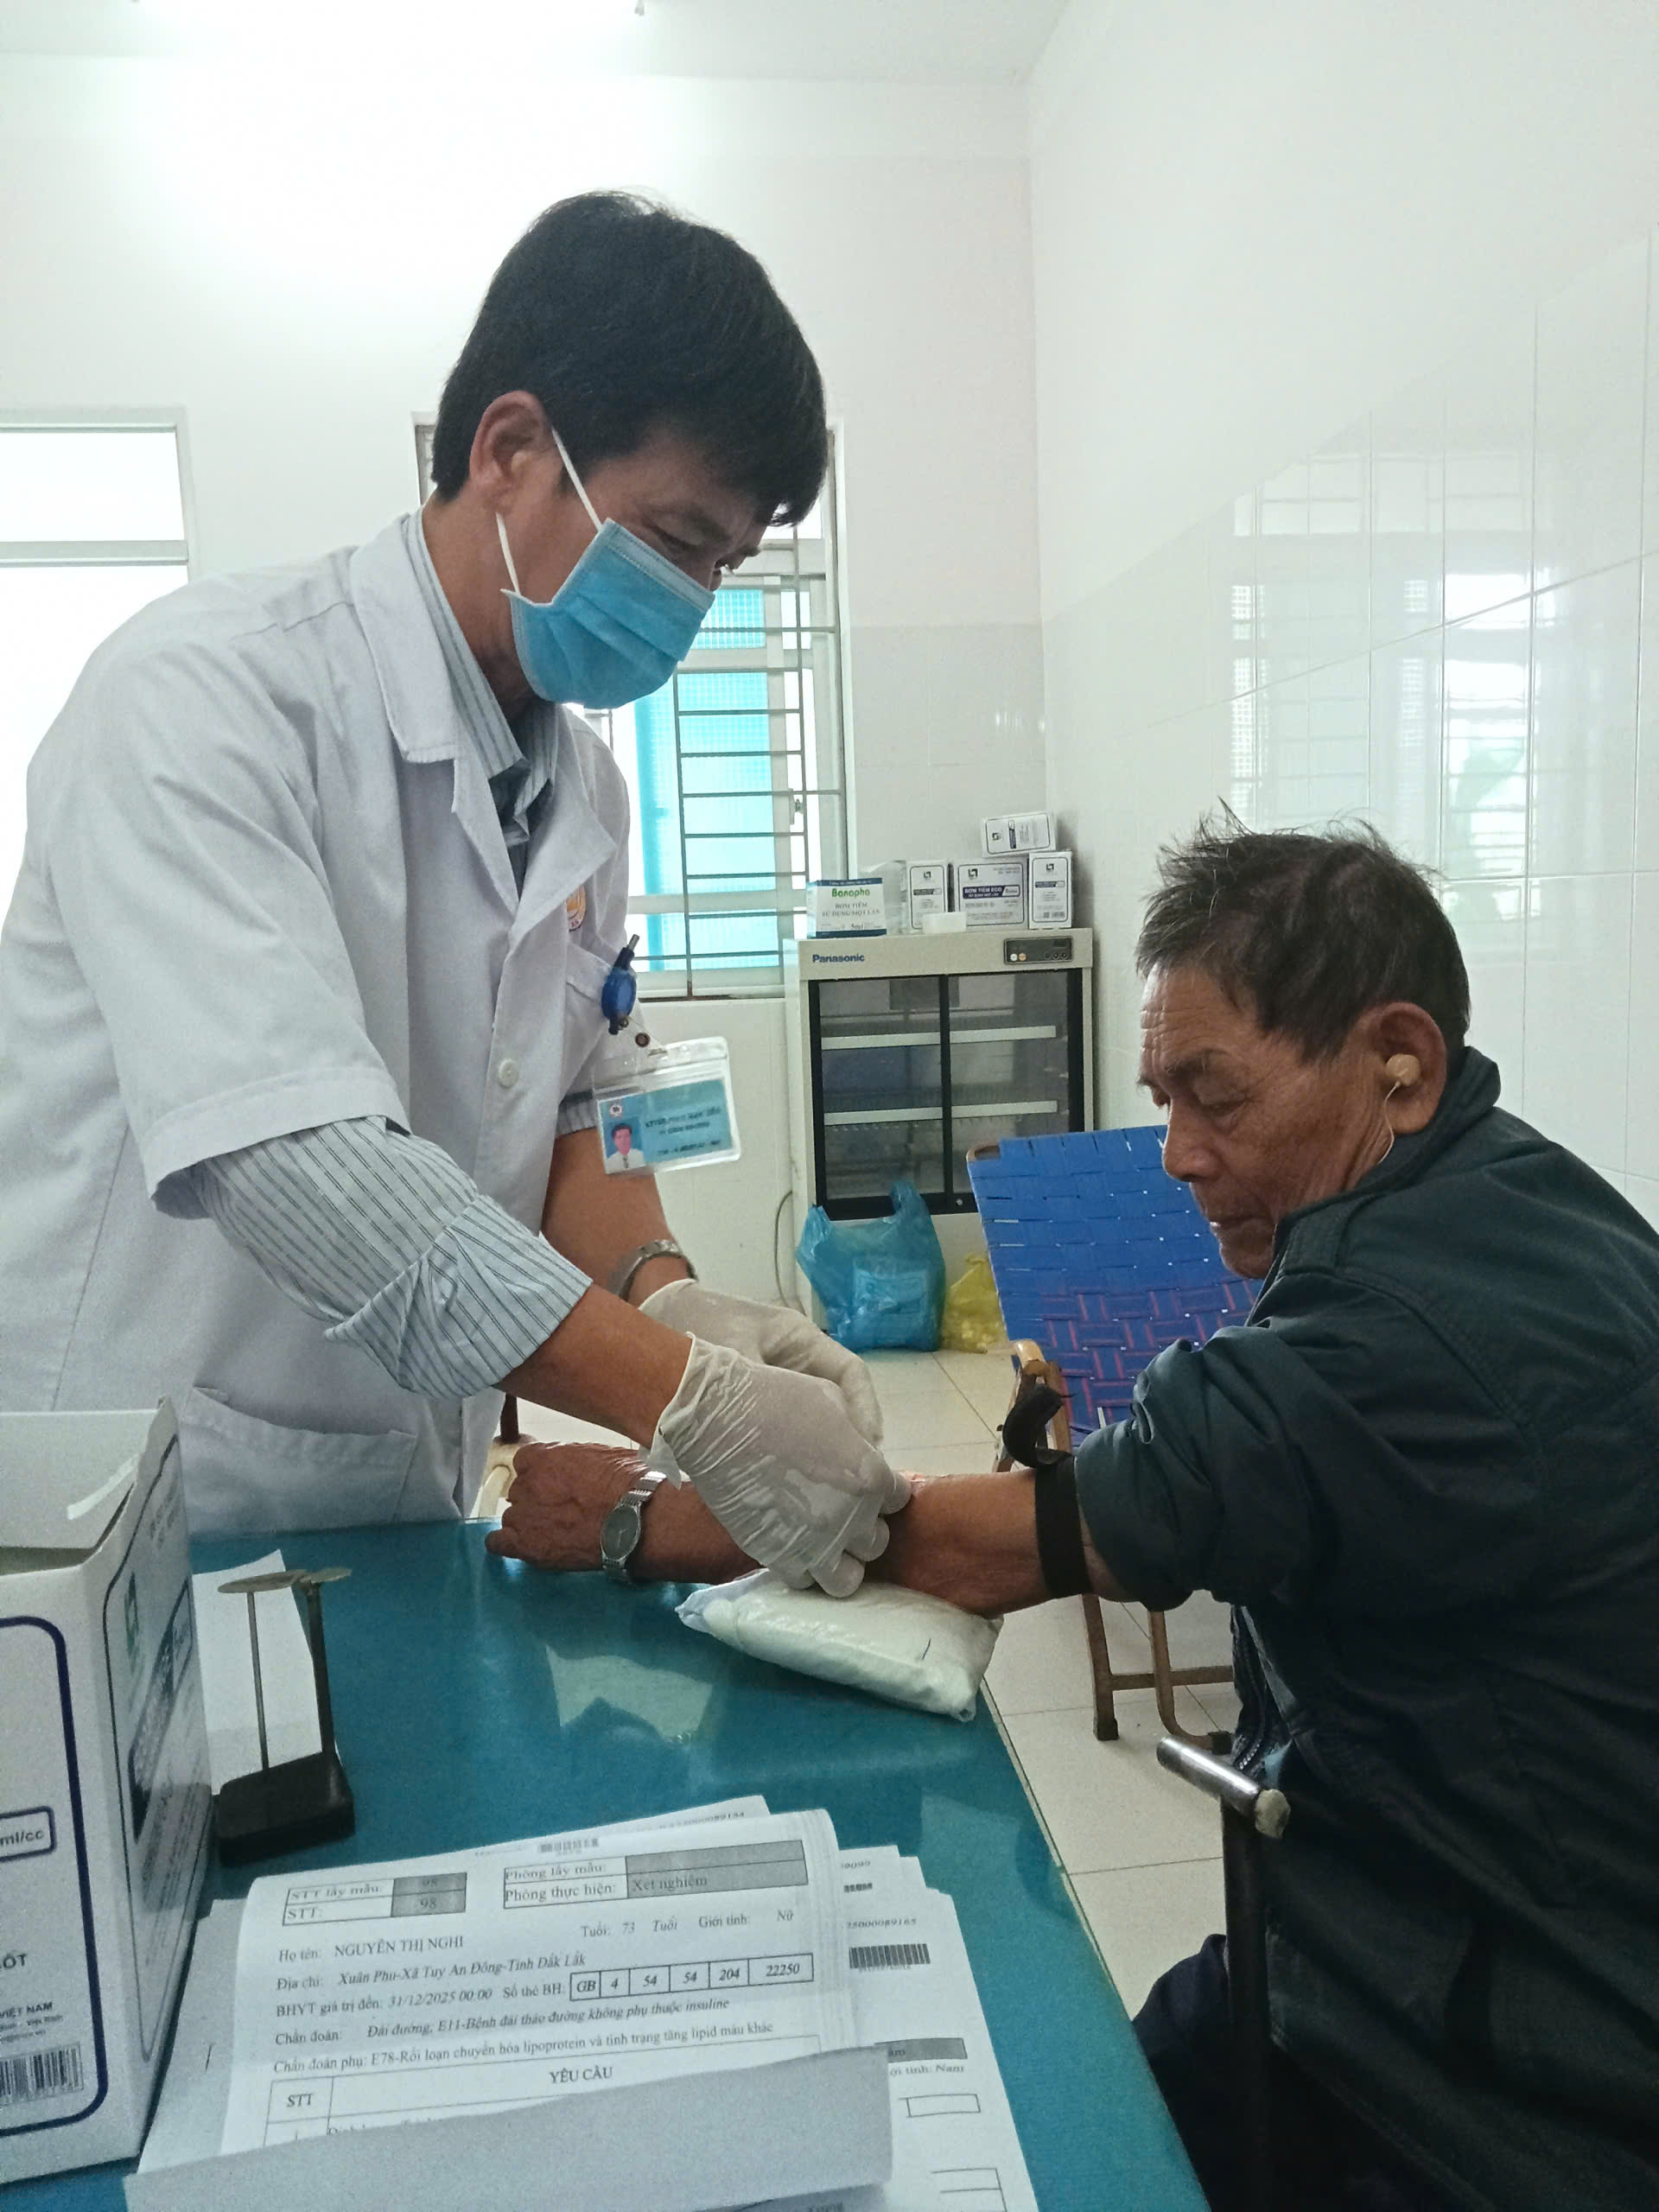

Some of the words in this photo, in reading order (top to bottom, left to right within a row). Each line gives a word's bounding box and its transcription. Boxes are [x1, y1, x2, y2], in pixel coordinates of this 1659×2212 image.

[812, 953, 865, 963] Panasonic
[290, 1888, 321, 1901] STT
[419, 1897, 437, 1910] 98
[505, 1889, 547, 1903] Phòng
[550, 1886, 579, 1898] thực
[622, 1922, 635, 1935] 73
[777, 1909, 793, 1923] Nữ
[278, 1948, 296, 1962] Họ
[398, 1939, 424, 1953] THỊ
[276, 1977, 299, 1991] Địa
[337, 1971, 370, 1986] Xuân
[423, 1965, 446, 1980] Tuy
[448, 1962, 467, 1976] An
[576, 1979, 597, 1993] GB
[610, 1977, 619, 1990] 4
[643, 1974, 658, 1988] 54
[683, 1971, 698, 1985] 54
[719, 1967, 741, 1982] 204
[766, 1962, 801, 1978] 22250
[26, 2000, 53, 2014] NAM
[276, 2002, 317, 2018] BHYT
[320, 2000, 338, 2017] giá
[388, 1990, 455, 2008] 31/12/2025
[502, 1983, 518, 1999] Số
[437, 2015, 497, 2032] E11-Bệnh
[588, 2006, 624, 2021] không
[626, 2004, 648, 2020] phụ
[651, 2000, 683, 2015] thuộc
[685, 1998, 730, 2012] insuline
[425, 2047, 450, 2062] loạn
[523, 2037, 586, 2056] lipoprotein
[632, 2031, 660, 2046] trạng
[691, 2024, 717, 2042] lipid
[549, 2066, 579, 2084] YÊU
[582, 2064, 613, 2082] CẦU
[287, 2093, 314, 2108] STT
